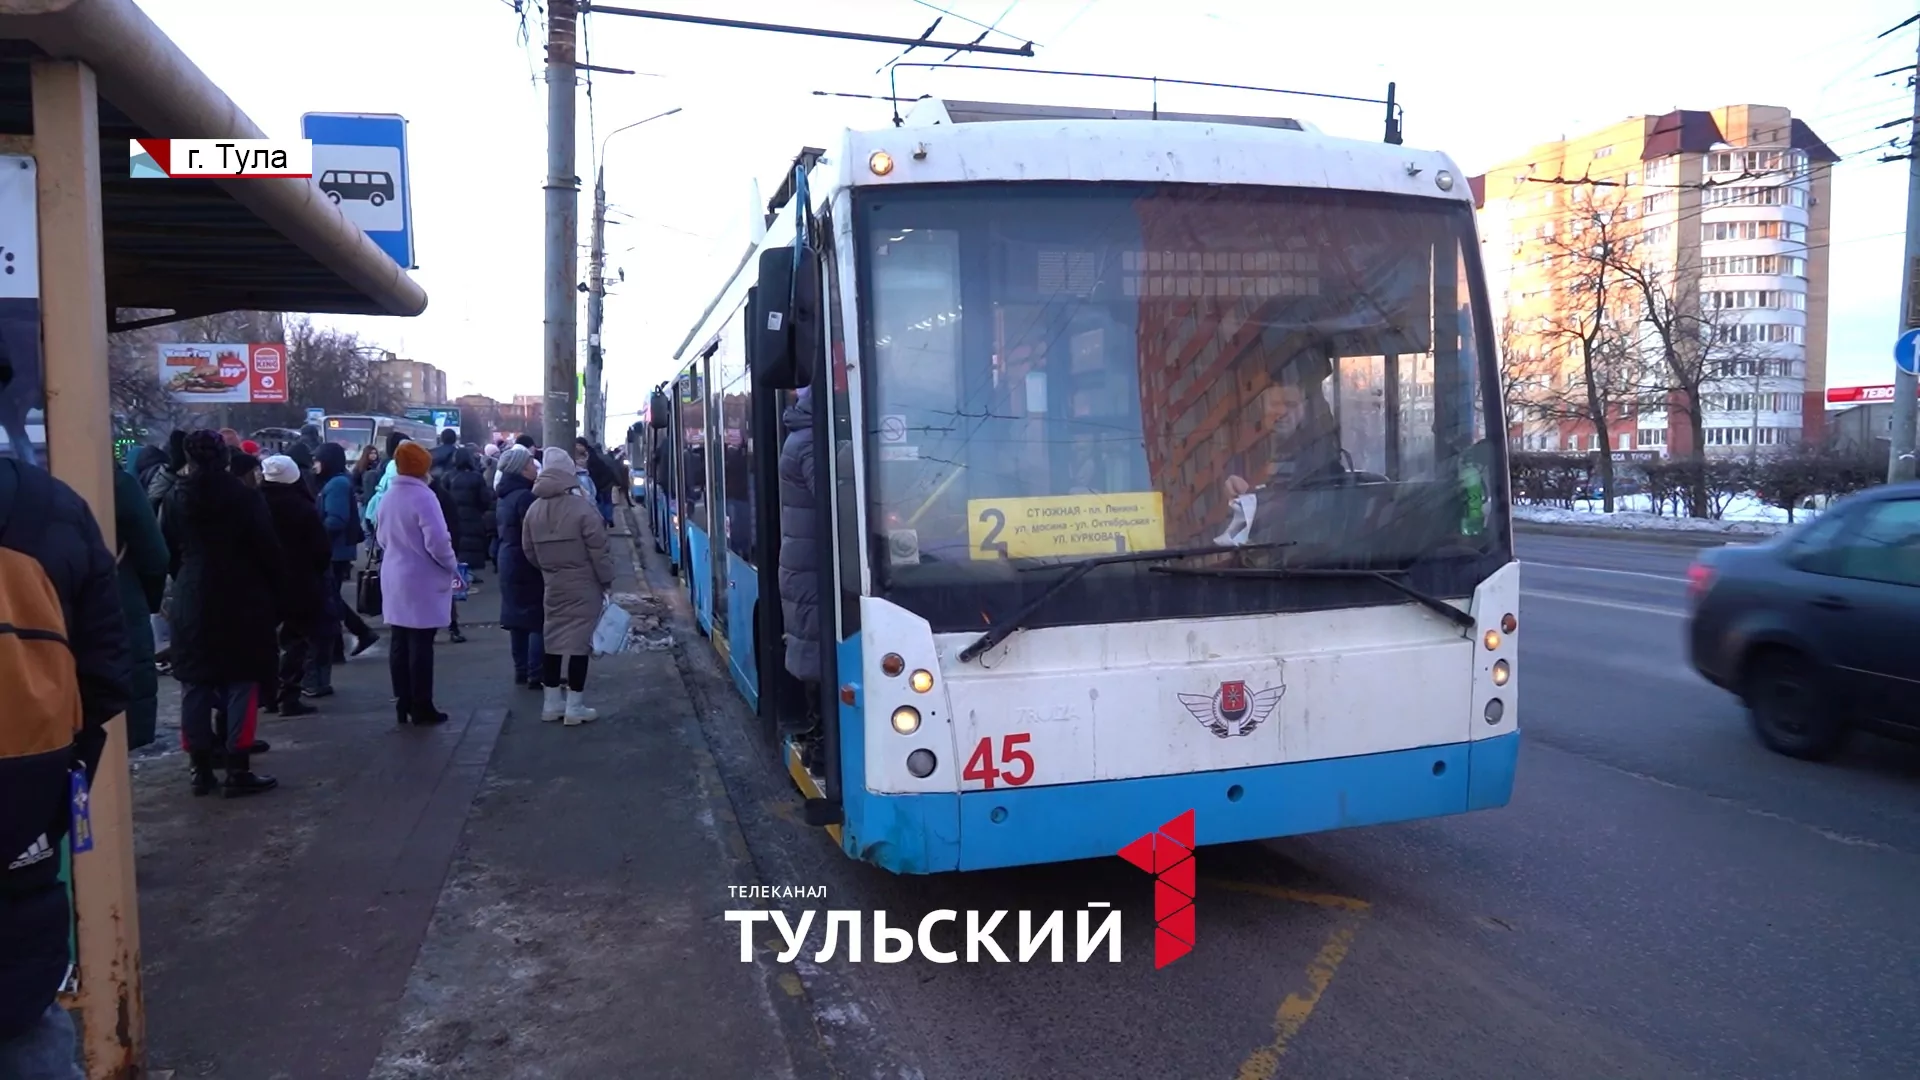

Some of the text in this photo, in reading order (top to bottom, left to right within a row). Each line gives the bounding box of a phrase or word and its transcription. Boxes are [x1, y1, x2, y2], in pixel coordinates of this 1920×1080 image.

[1862, 387, 1895, 399] TEBO
[1042, 506, 1081, 517] ЮЖНАЯ
[979, 508, 1006, 552] 2
[962, 733, 1034, 788] 45
